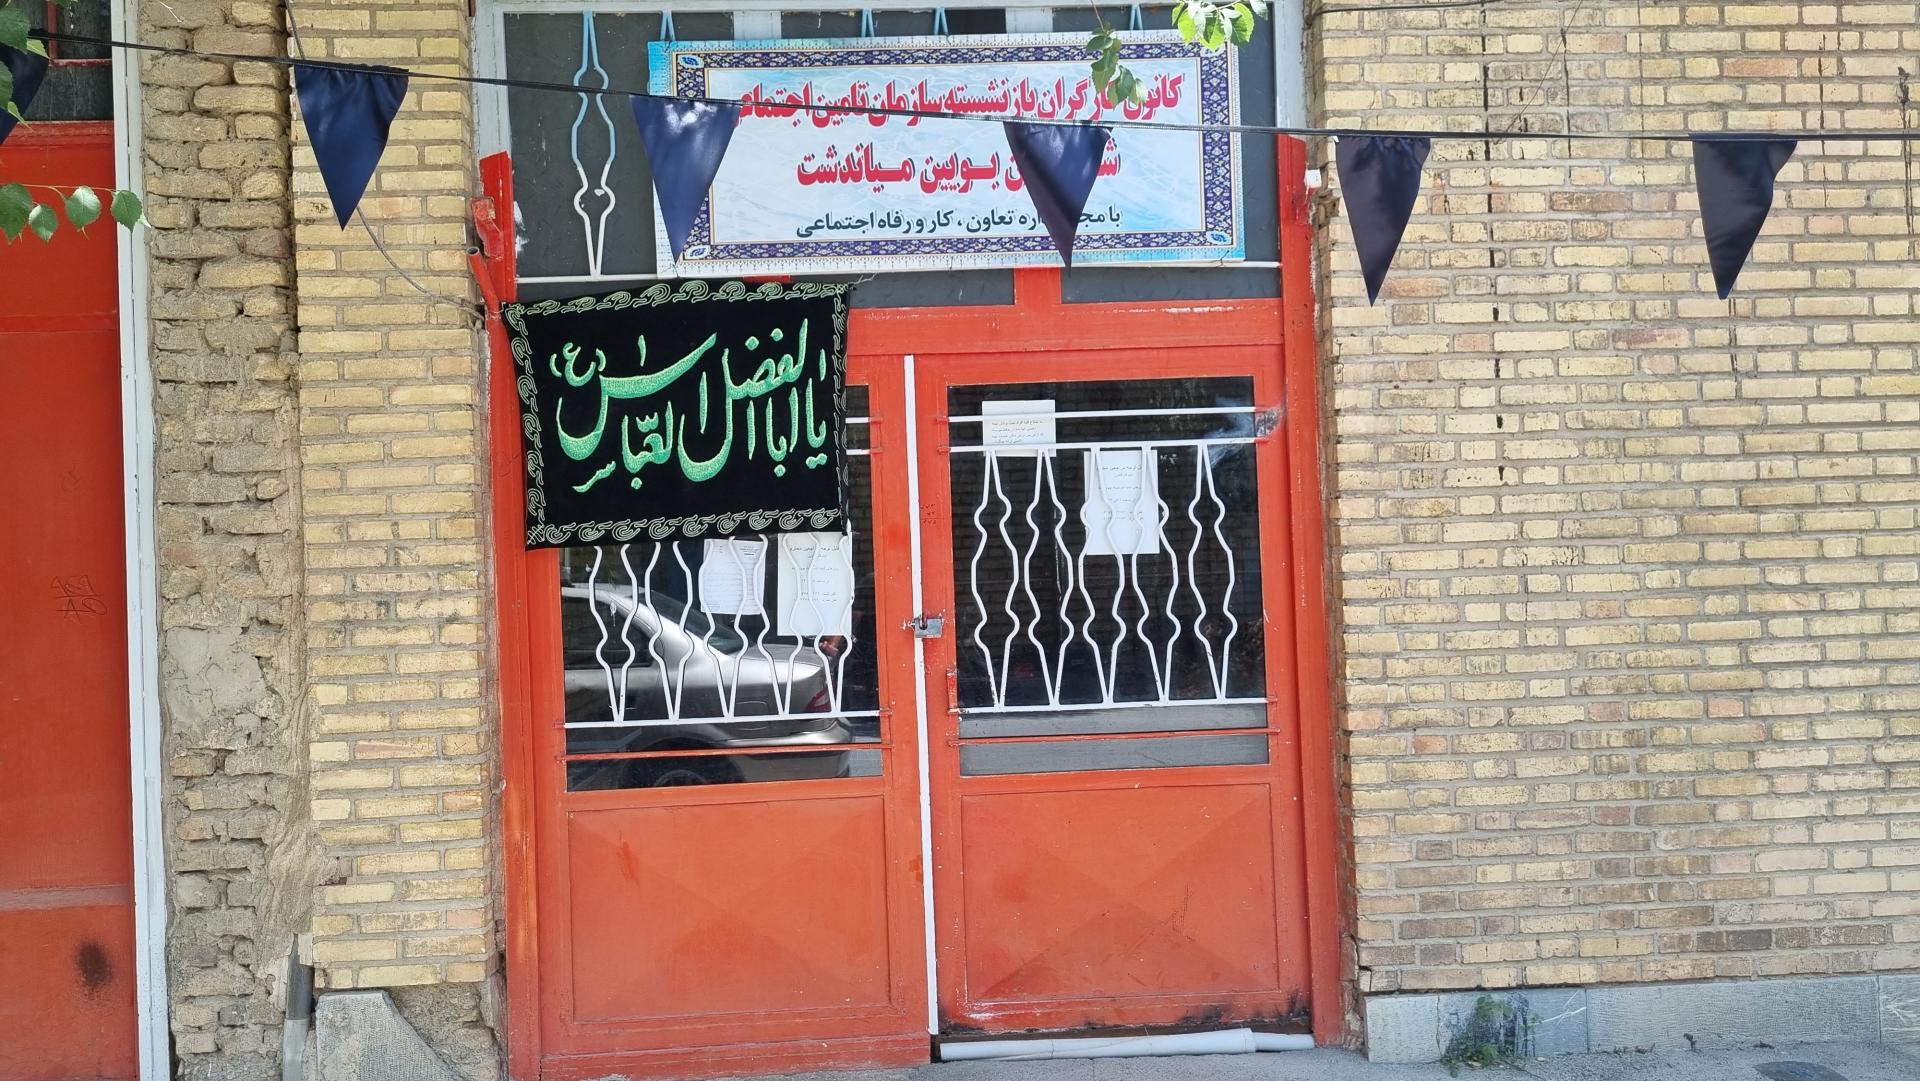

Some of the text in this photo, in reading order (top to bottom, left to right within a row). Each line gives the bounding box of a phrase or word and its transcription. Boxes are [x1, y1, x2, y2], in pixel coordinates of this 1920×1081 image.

[733, 81, 814, 128] اجتماع
[868, 79, 945, 127] سازمان
[943, 77, 1036, 119] بازنشسته
[1122, 72, 1185, 121] کانون
[796, 141, 916, 193] میاندشت
[795, 210, 875, 239] اجتماعی
[928, 209, 954, 231] کار
[1108, 204, 1122, 228] با
